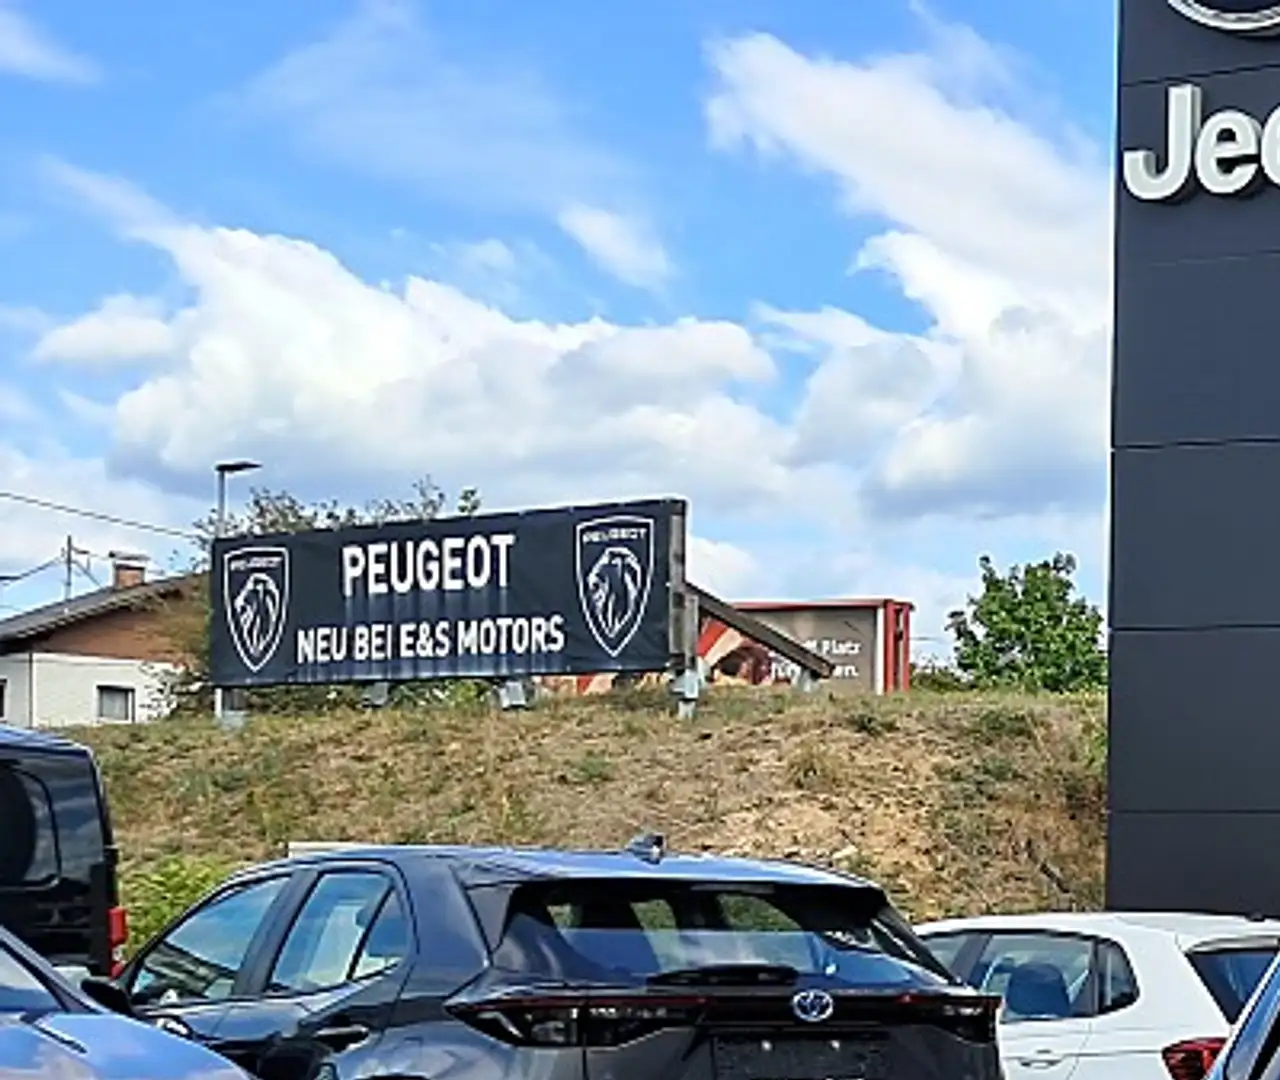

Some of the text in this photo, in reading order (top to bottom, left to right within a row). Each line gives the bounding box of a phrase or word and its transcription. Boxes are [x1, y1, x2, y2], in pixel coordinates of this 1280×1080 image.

[342, 534, 515, 597] PEUGEOT
[297, 615, 565, 663] NEU BEI E&S MOTORS
